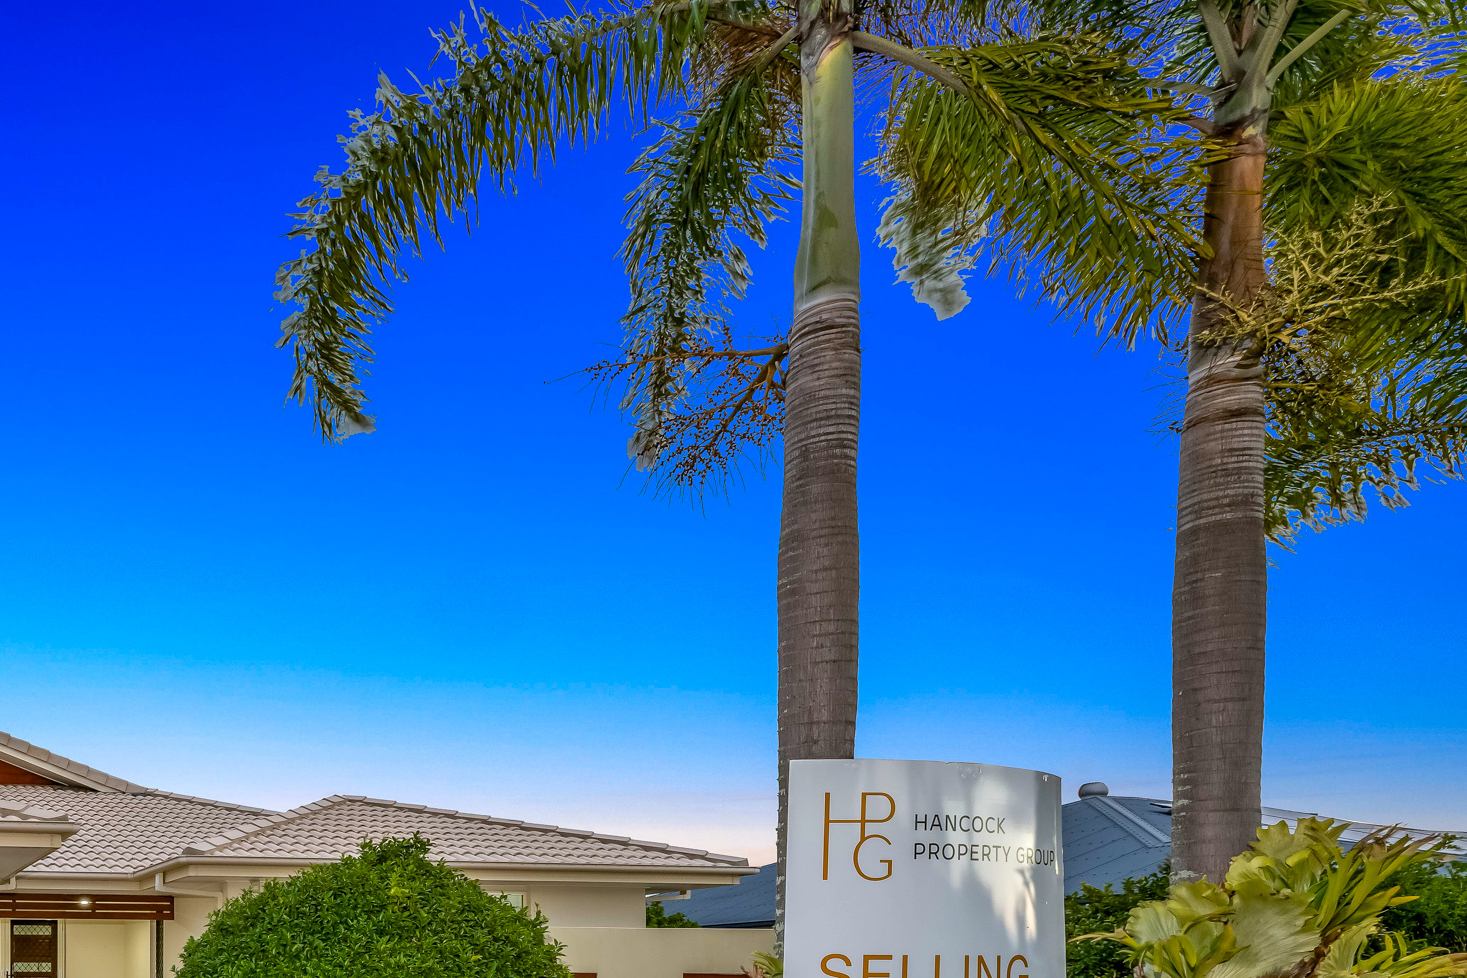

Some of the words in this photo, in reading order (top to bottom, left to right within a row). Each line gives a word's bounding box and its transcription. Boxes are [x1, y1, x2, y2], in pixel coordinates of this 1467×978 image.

[913, 813, 1006, 835] HANCOCK
[913, 842, 1011, 863] PROPERTY
[1016, 846, 1055, 867] GROUP
